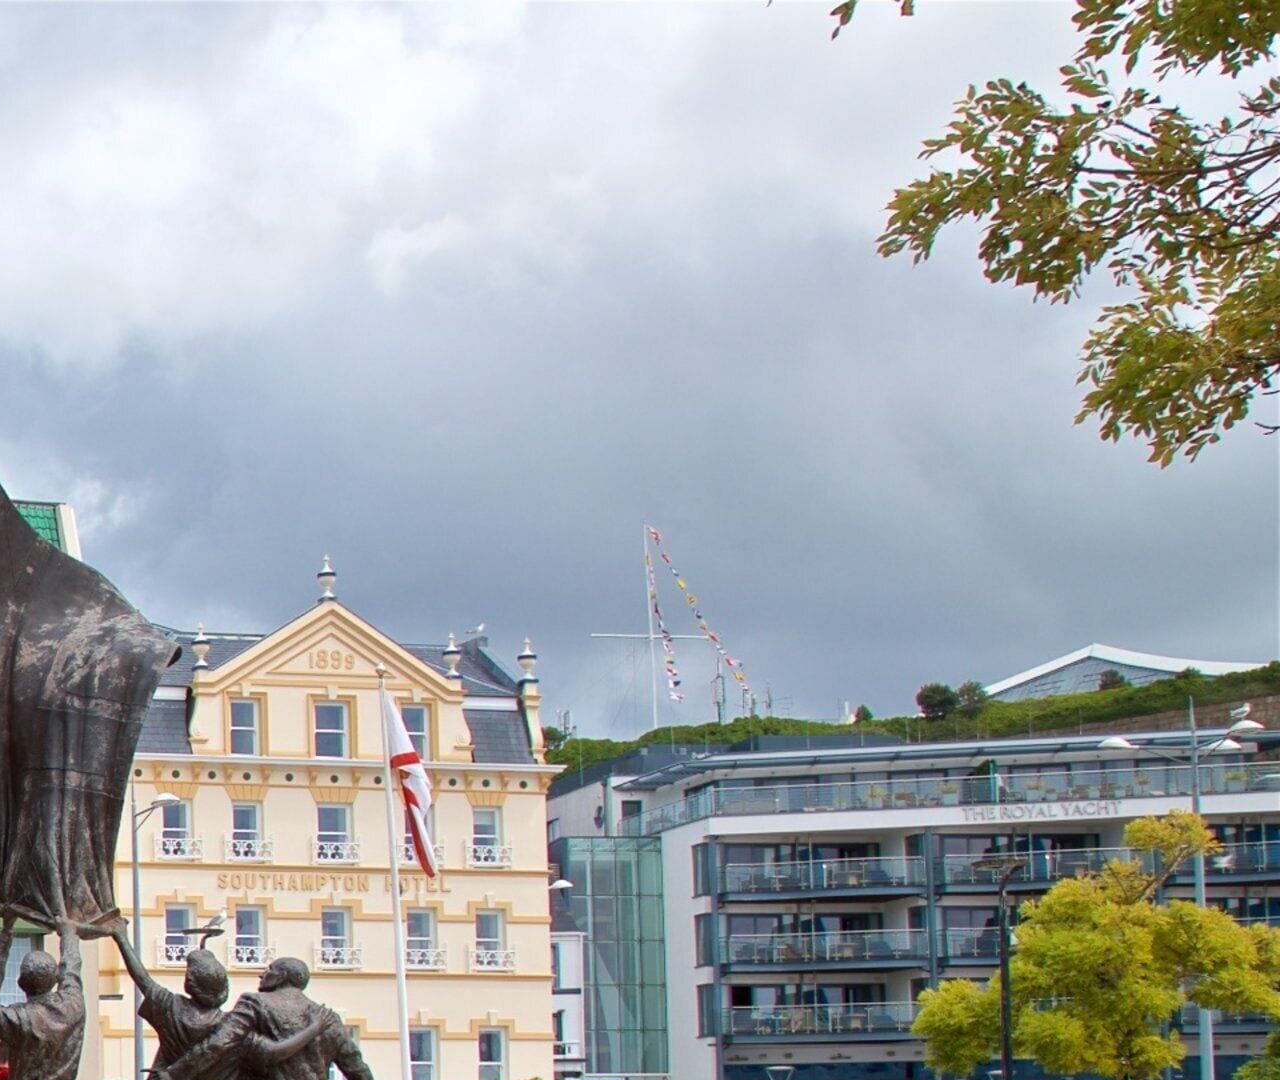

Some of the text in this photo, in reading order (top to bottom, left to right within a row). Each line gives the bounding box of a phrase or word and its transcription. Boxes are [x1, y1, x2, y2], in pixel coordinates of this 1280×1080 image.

[308, 649, 355, 671] 1899
[961, 800, 1122, 821] THE ROYAL YACHT
[217, 872, 370, 892] SOUTHAMPTON
